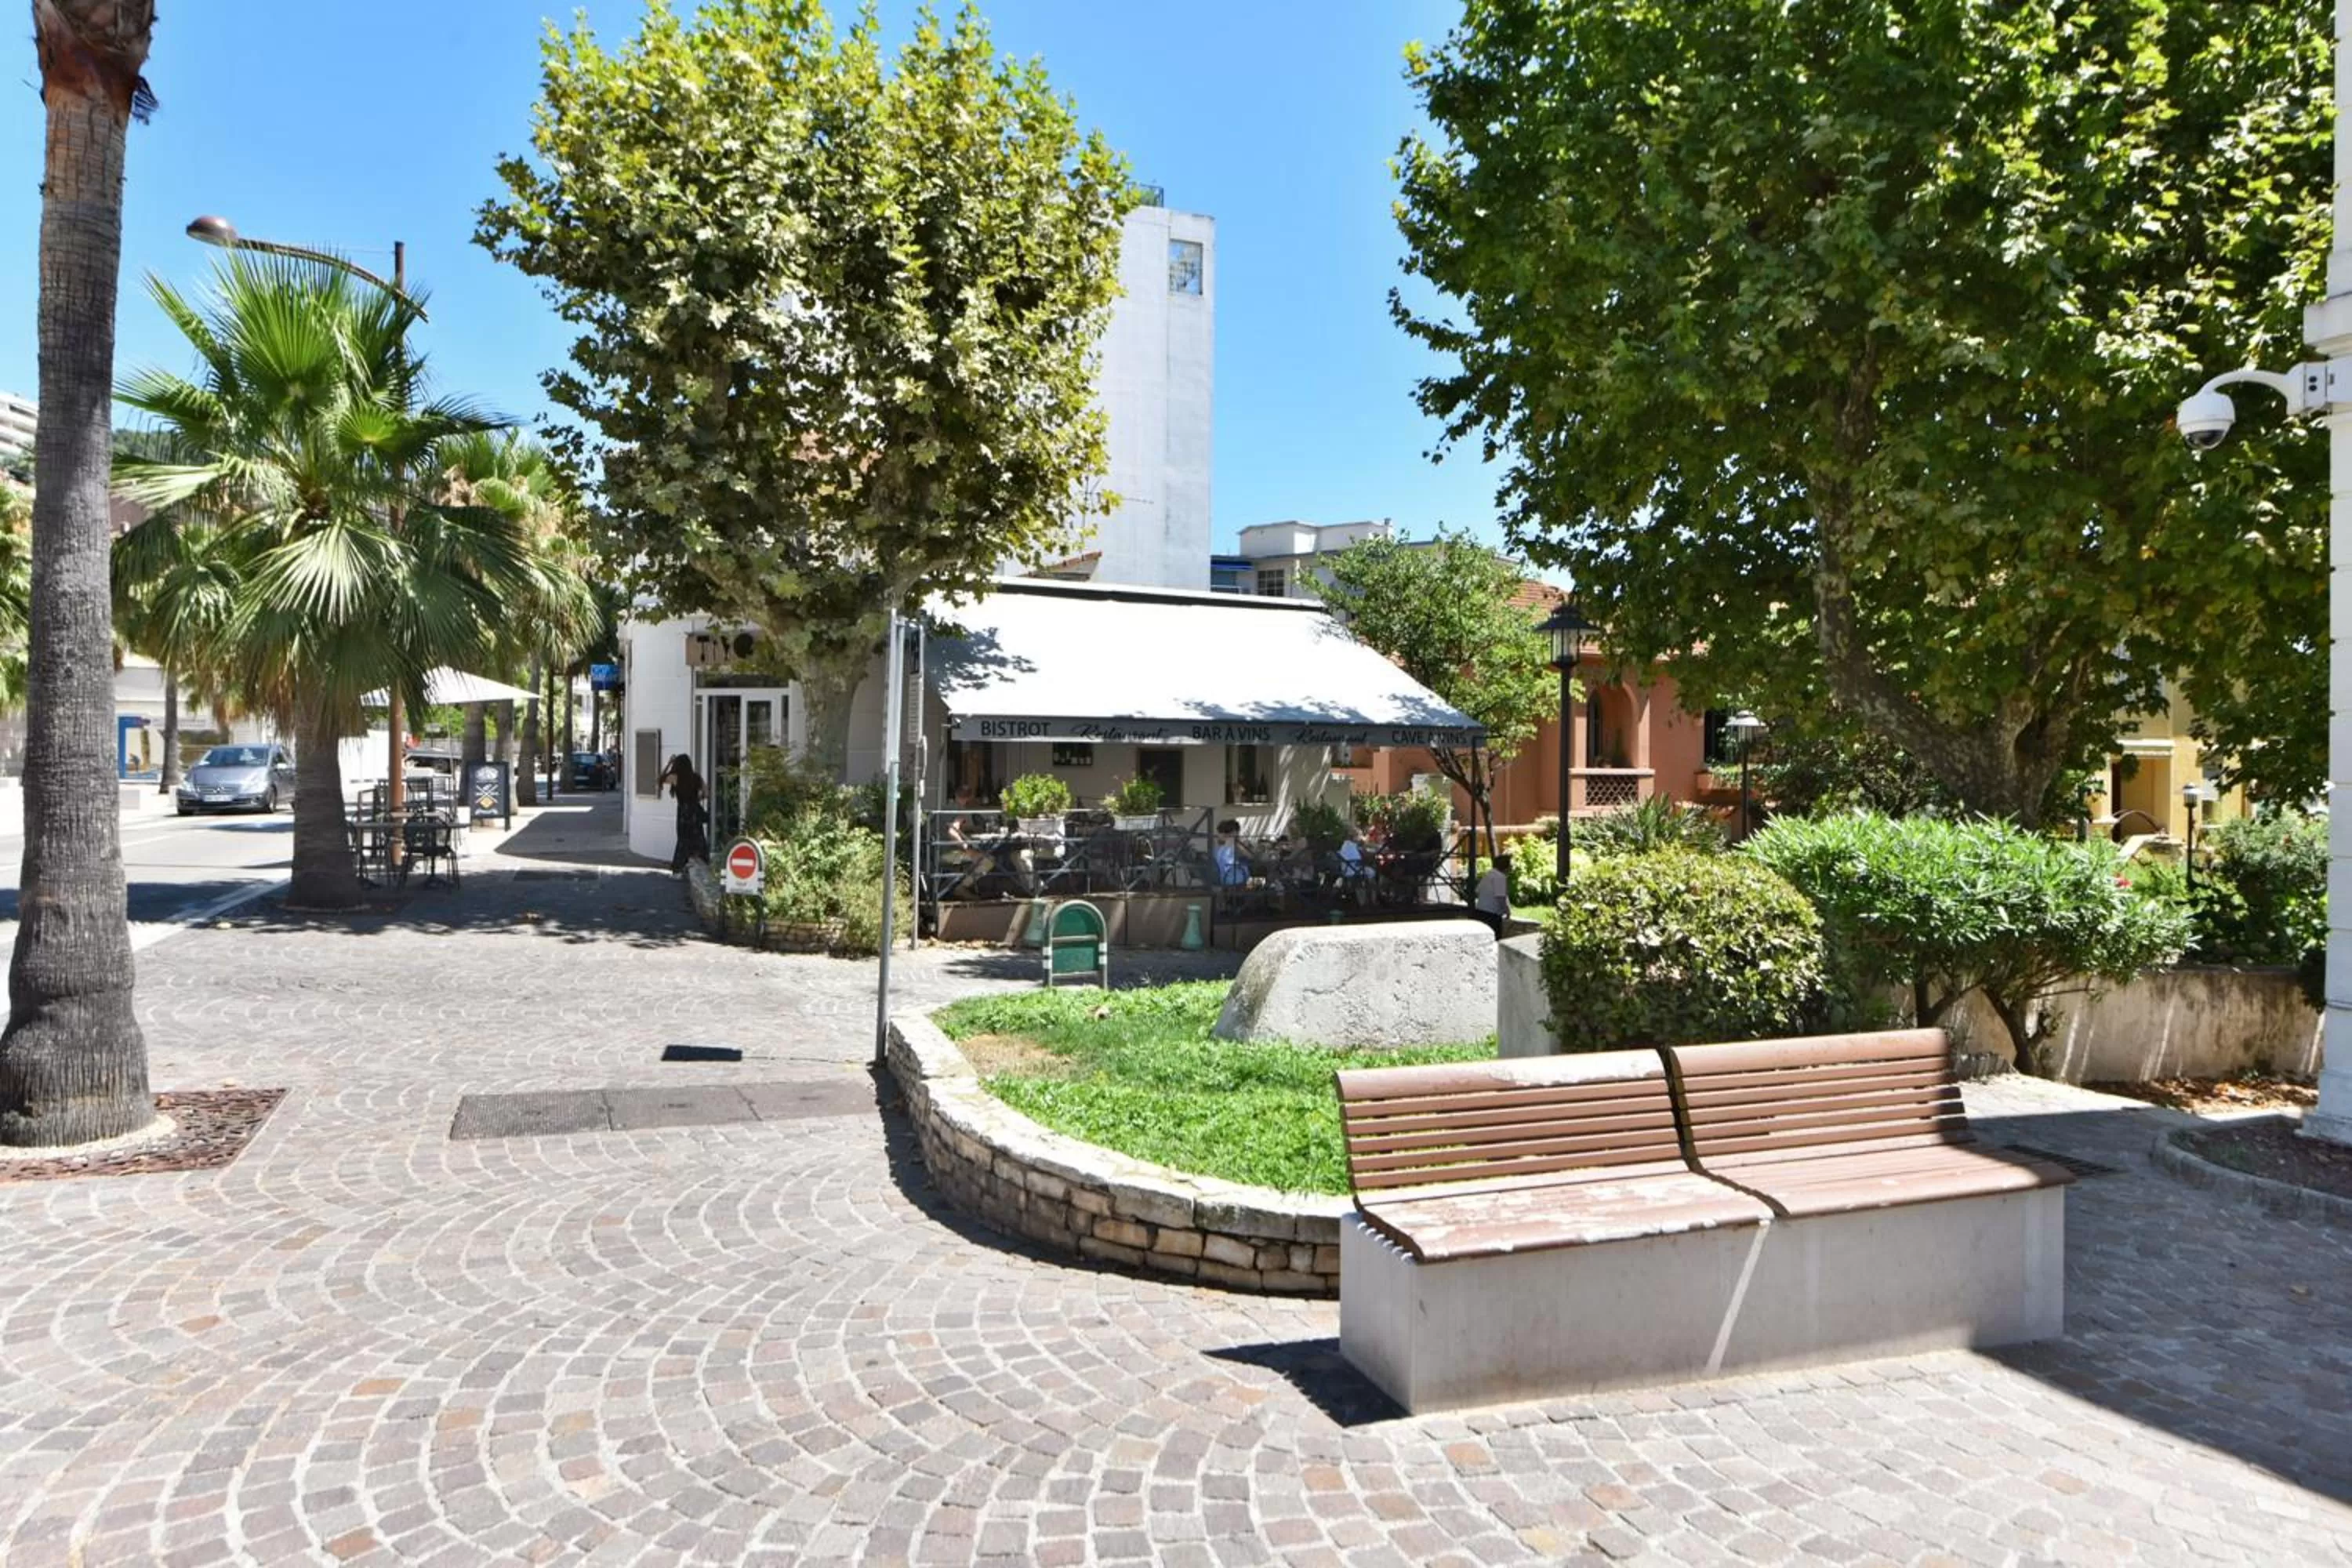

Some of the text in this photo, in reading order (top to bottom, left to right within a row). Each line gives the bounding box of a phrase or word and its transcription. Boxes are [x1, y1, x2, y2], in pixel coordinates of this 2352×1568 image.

[981, 720, 1051, 736] BISTROT
[1192, 725, 1221, 740] BAR
[1237, 726, 1271, 741] VINS
[1392, 730, 1425, 744] CAVE
